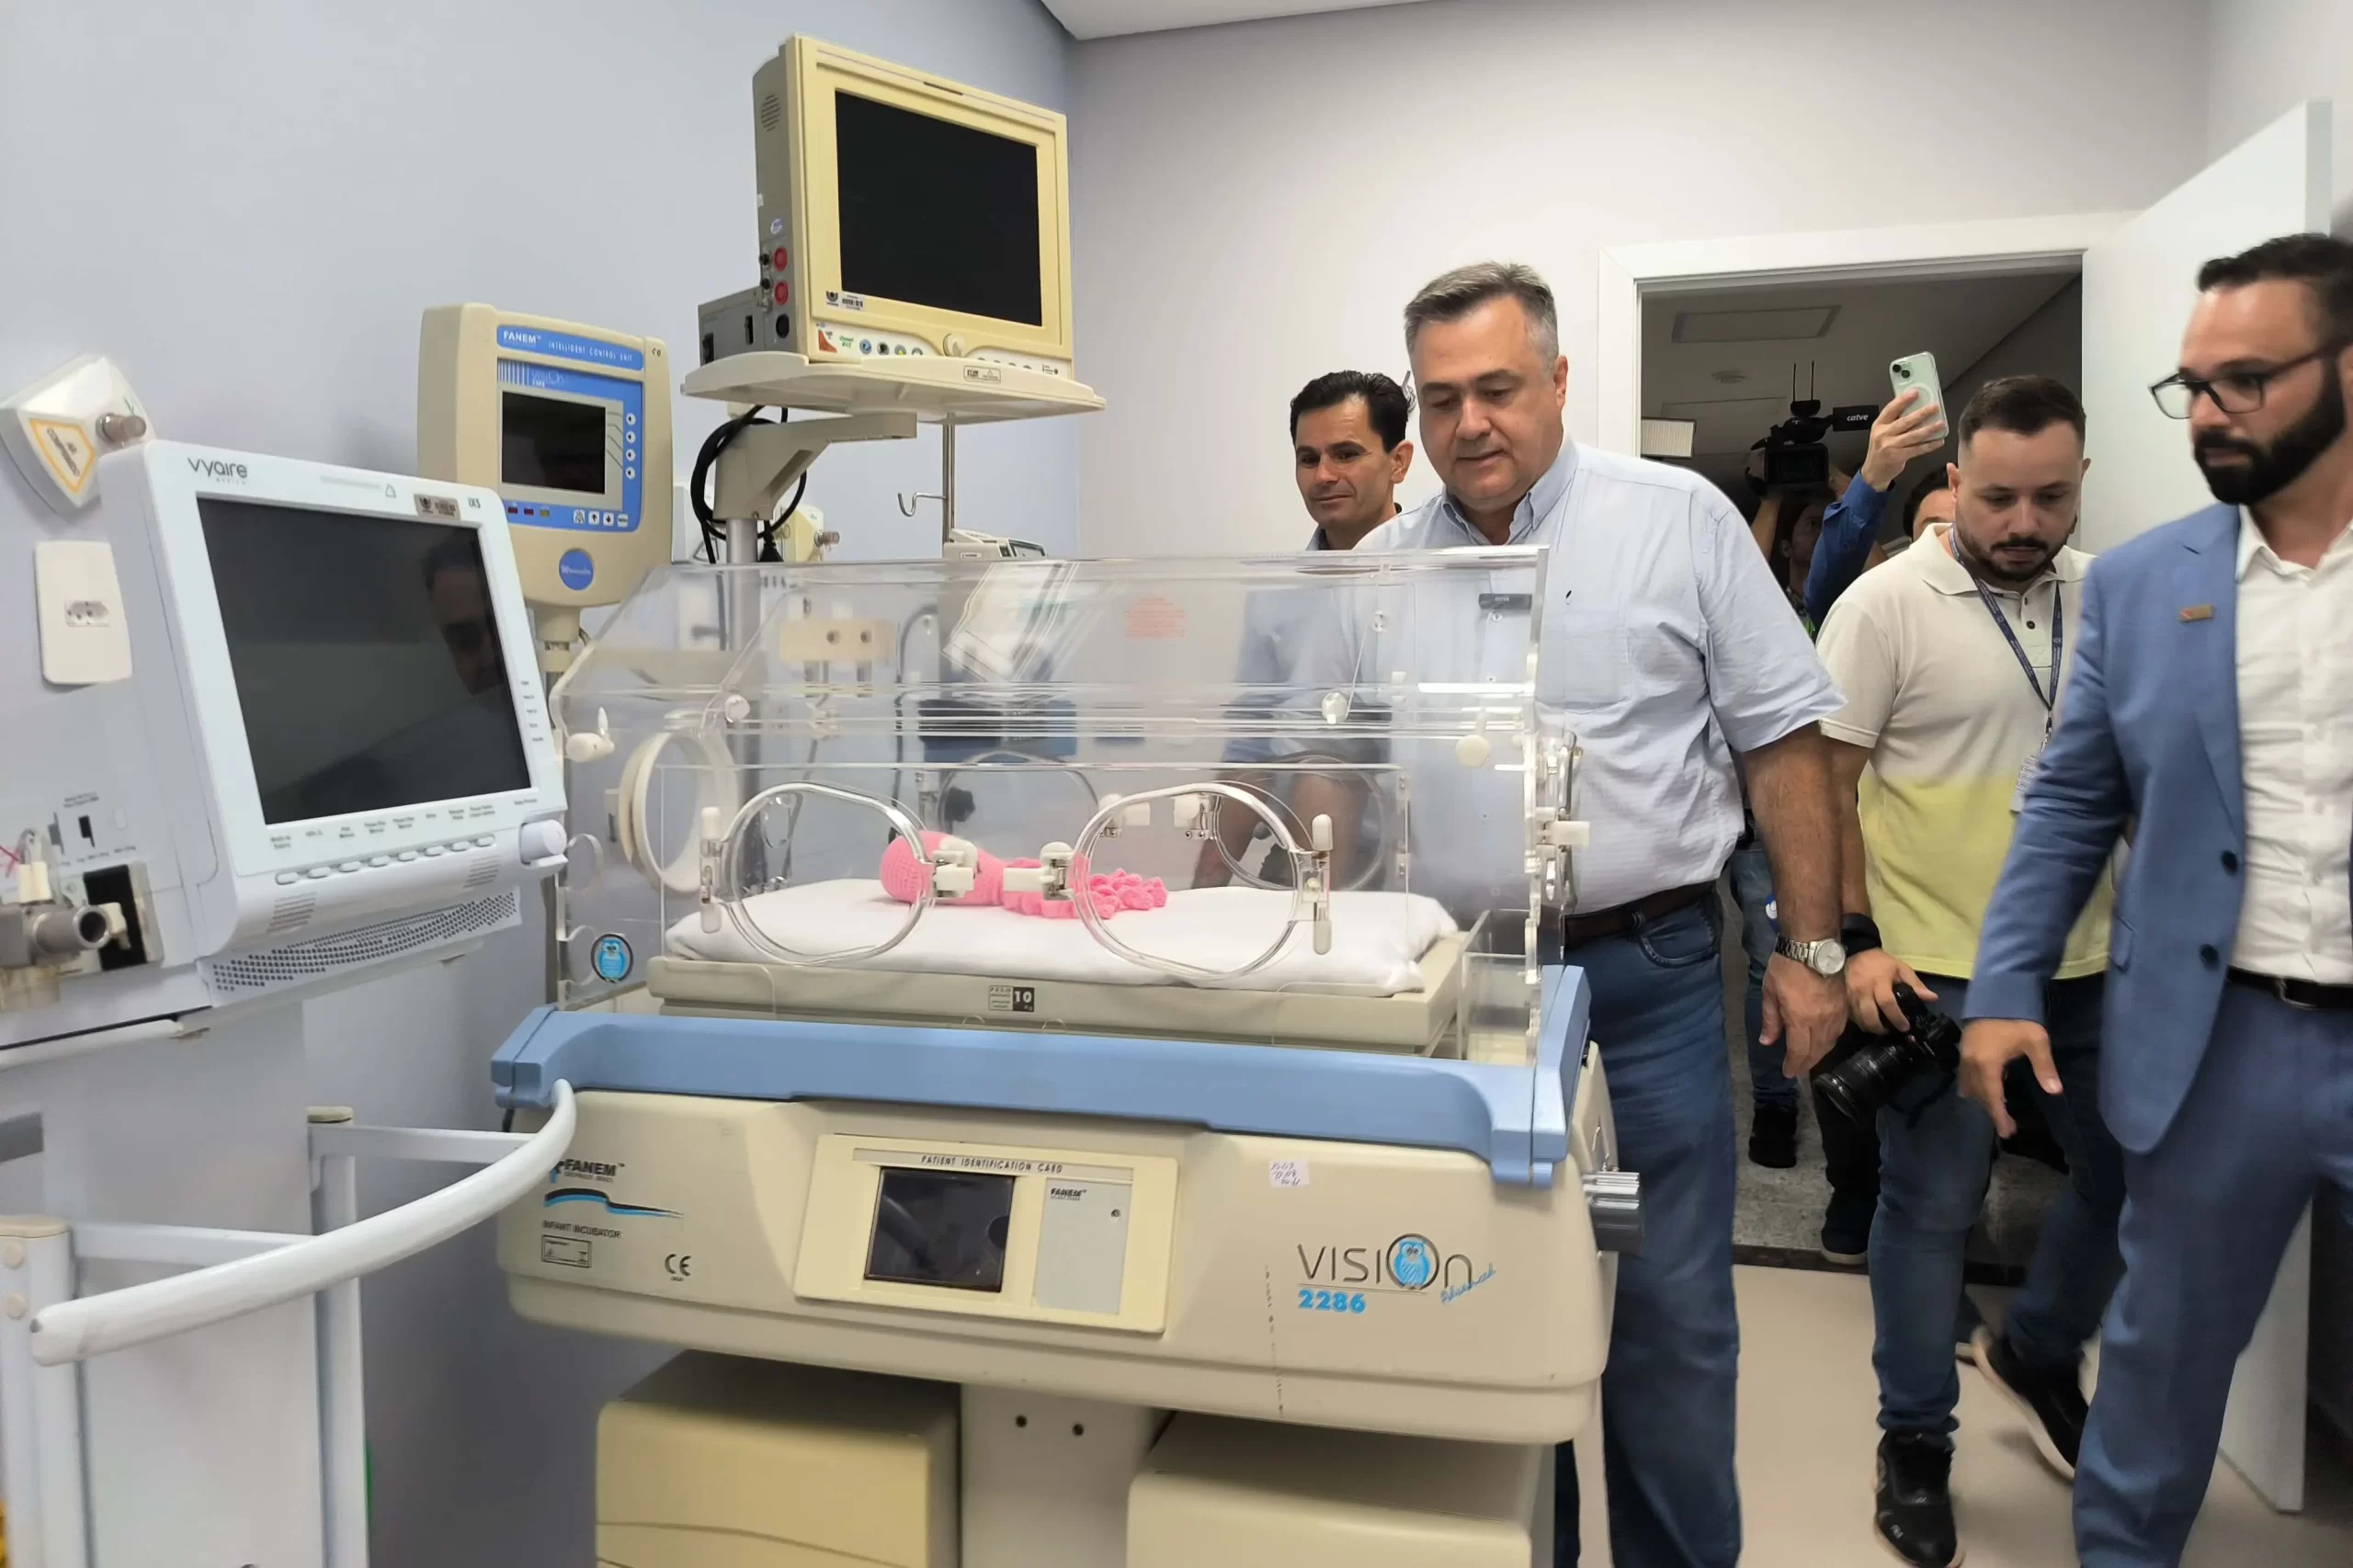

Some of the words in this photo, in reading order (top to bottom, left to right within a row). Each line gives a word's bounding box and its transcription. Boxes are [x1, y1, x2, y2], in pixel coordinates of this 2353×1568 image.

[503, 330, 538, 345] FANEM
[589, 347, 617, 360] CONTROL
[1847, 414, 1869, 422] catve
[187, 458, 248, 479] vyaire
[1014, 990, 1032, 1004] 10
[563, 1158, 617, 1177] FANEM
[921, 1154, 956, 1166] PATIENT
[961, 1158, 1031, 1171] IDENTIFICATION
[1037, 1163, 1063, 1174] CARD
[541, 1220, 571, 1232] INFANT
[573, 1224, 622, 1240] INCUBATOR
[1297, 1288, 1366, 1314] 2286
